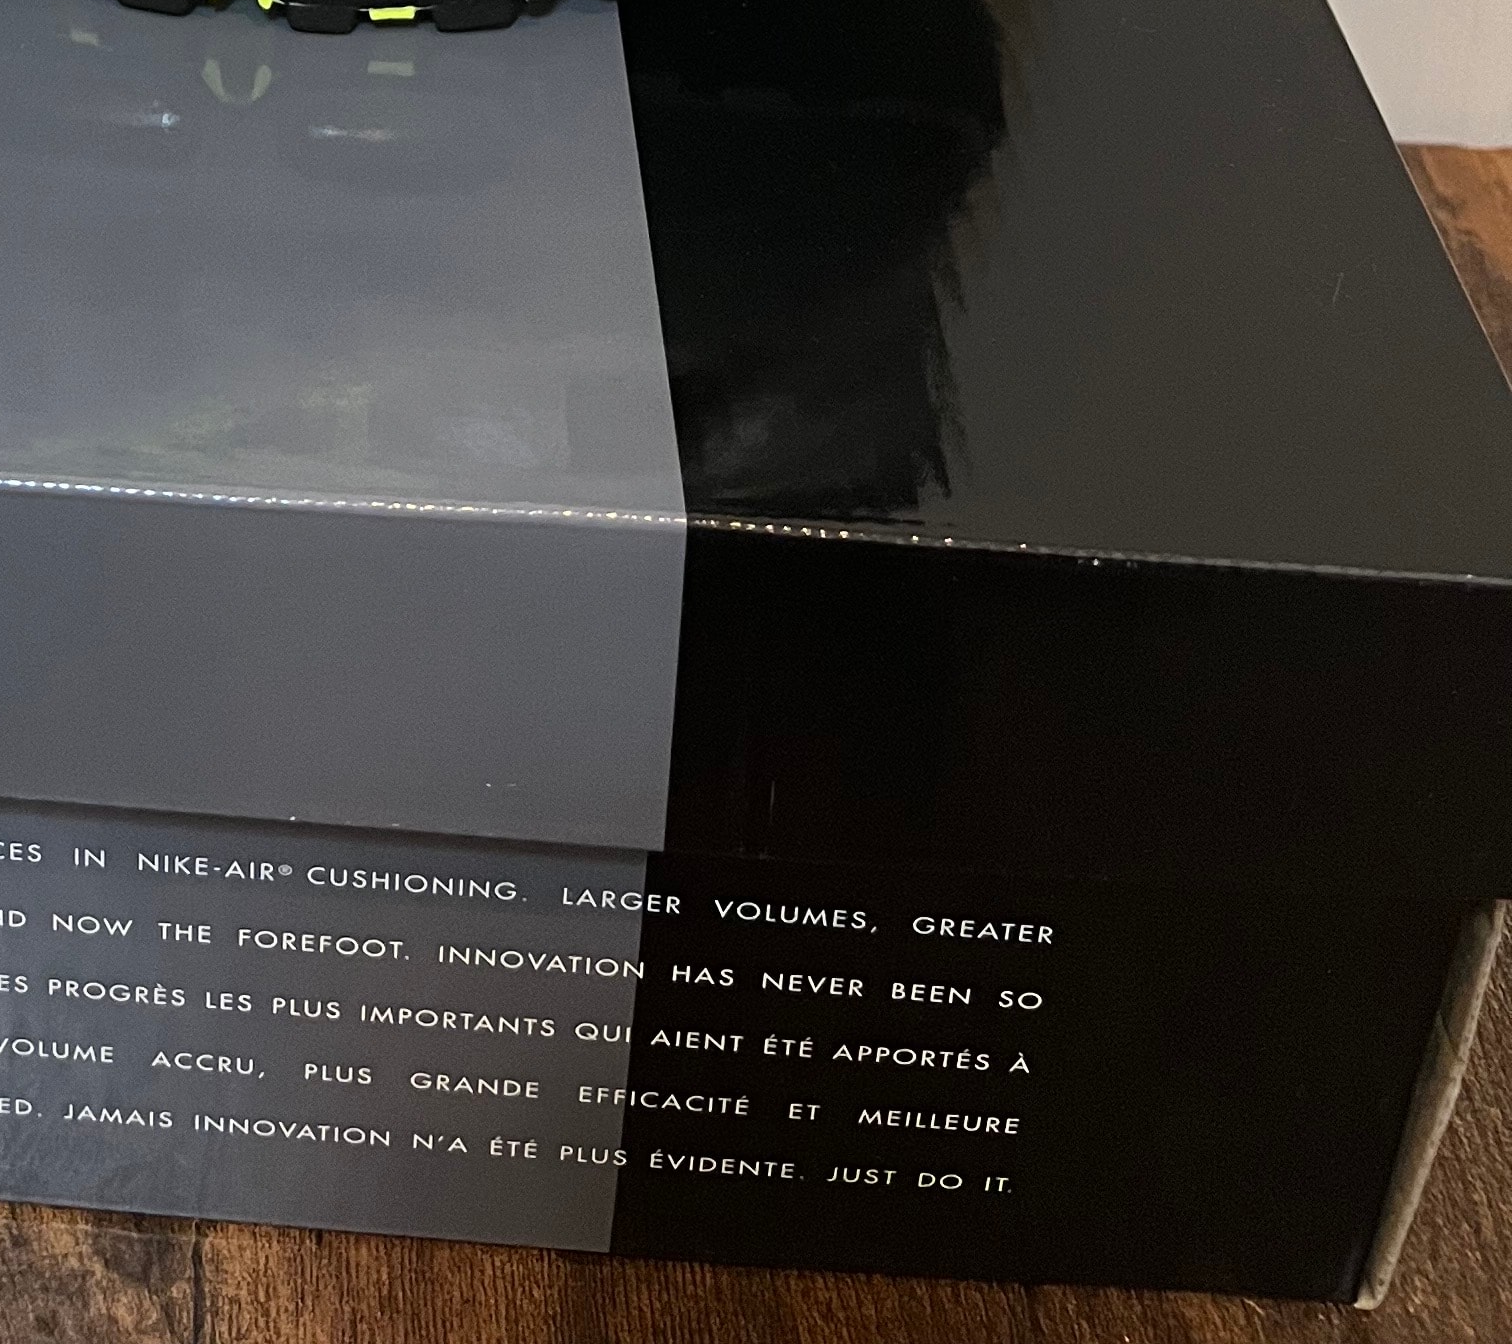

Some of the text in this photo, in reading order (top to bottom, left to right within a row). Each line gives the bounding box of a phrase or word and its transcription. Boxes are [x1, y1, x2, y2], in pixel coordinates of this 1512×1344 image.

[73, 847, 106, 869] IN
[306, 866, 528, 902] CUSHIONING.
[562, 886, 681, 915] LARGER
[713, 898, 878, 934] VOLUMES,
[911, 915, 1054, 945] GREATER
[52, 913, 134, 937] NOW
[157, 922, 212, 945] THE
[238, 928, 410, 961] FOREFOOT.
[438, 945, 645, 980] INNOVATION
[671, 964, 735, 988] HAS
[761, 971, 864, 998] NEVER
[890, 981, 972, 1006] BEEN
[997, 989, 1044, 1011] SO
[48, 978, 186, 1008] PROGRÈS
[205, 991, 253, 1013] LES
[272, 996, 341, 1020] PLUS
[360, 1004, 556, 1038] IMPORTANTS
[574, 1022, 632, 1045] QUI
[649, 1028, 745, 1053] AIENT
[762, 1033, 814, 1059] ÉTÉ
[831, 1043, 991, 1072] APPORTÉS
[1008, 1051, 1031, 1075] À
[150, 1050, 265, 1080] ACCRU,
[304, 1062, 372, 1085] PLUS
[409, 1071, 540, 1099] GRANDE
[578, 1085, 750, 1116] EFFICACITÉ
[787, 1102, 822, 1121] ET
[857, 1108, 1021, 1135] MEILLEURE
[63, 1103, 173, 1129] JAMAIS
[194, 1113, 391, 1147] INNOVATION
[489, 1135, 538, 1159] ÉTÉ
[559, 1144, 628, 1167] PLUS
[649, 1148, 805, 1180] ÉVIDENTE.
[826, 1166, 898, 1186] JUST
[917, 1171, 964, 1191] DO
[983, 1175, 1013, 1194] IT.
